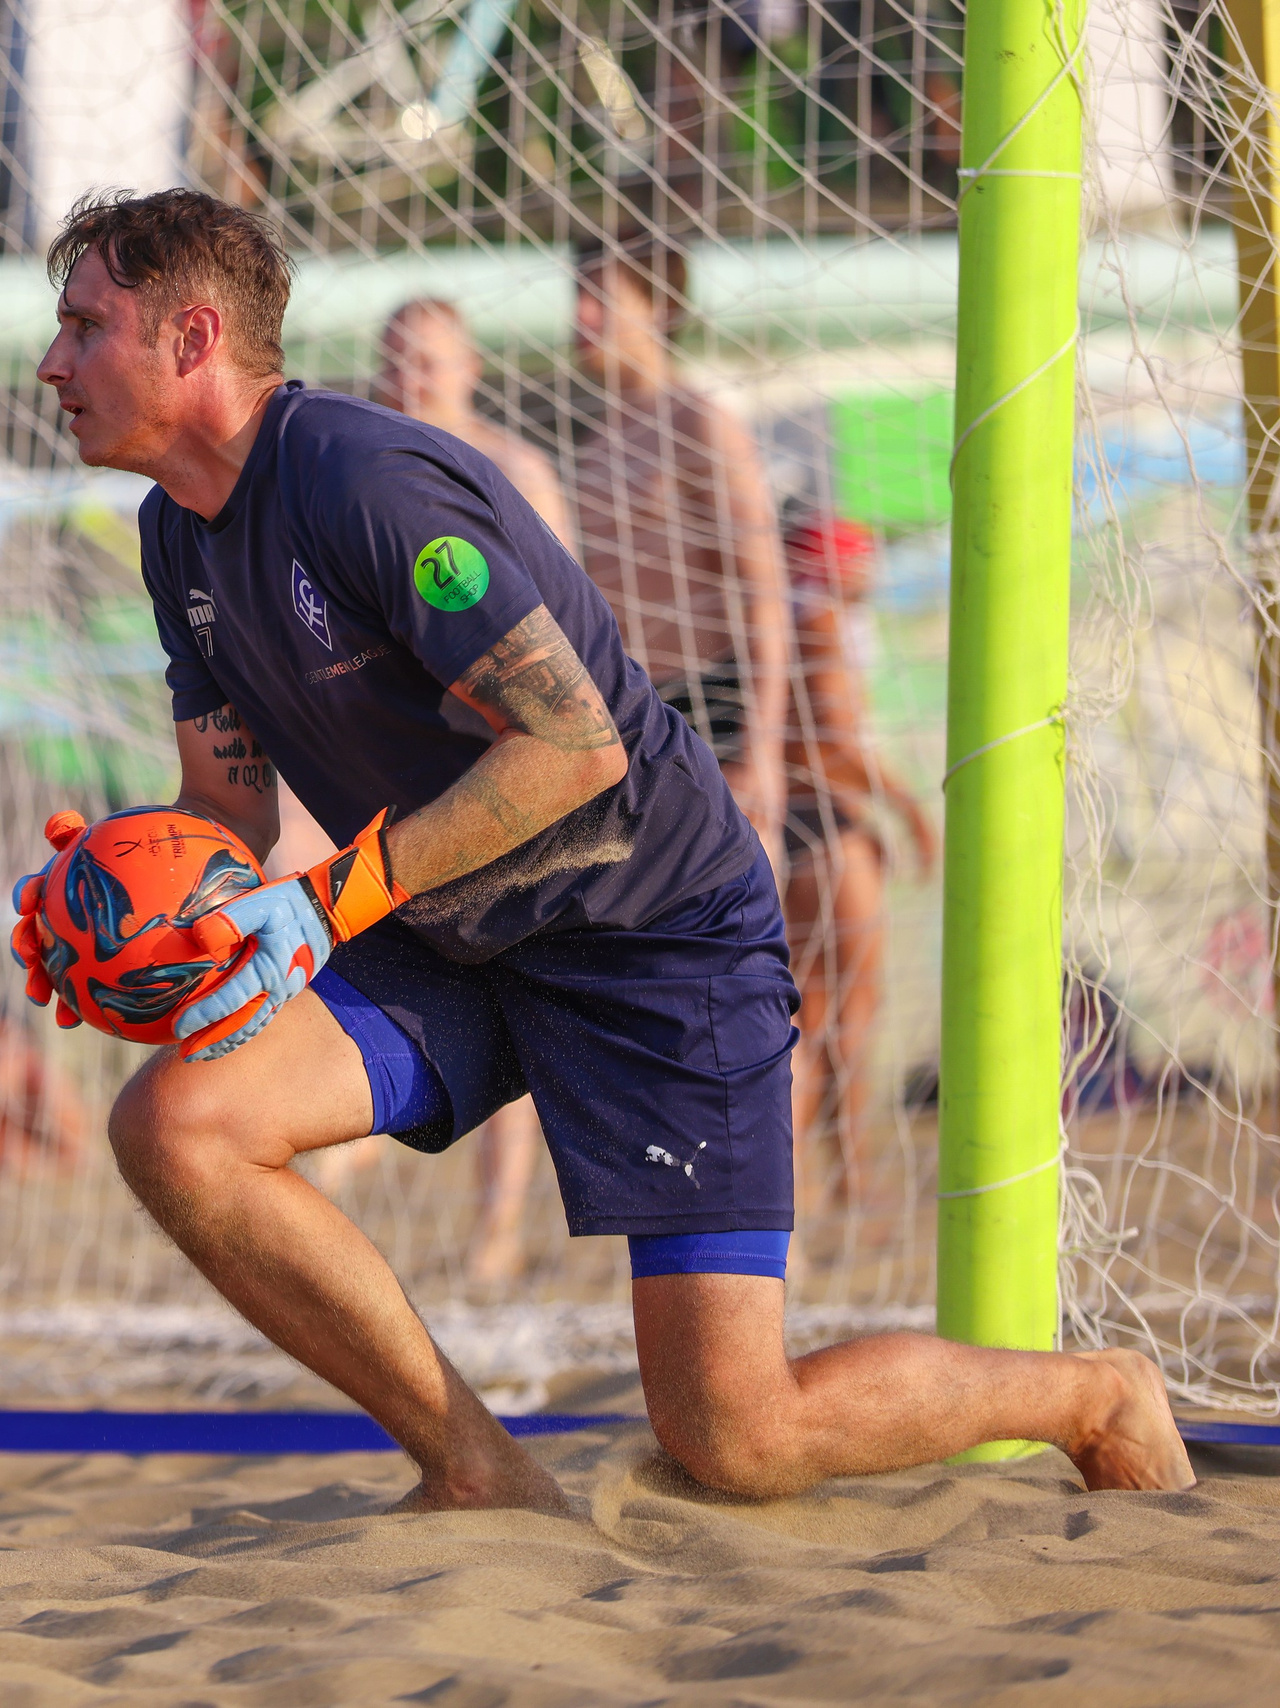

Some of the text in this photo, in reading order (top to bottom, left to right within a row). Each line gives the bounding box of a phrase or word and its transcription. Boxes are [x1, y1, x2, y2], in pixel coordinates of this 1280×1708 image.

[421, 540, 461, 591] 27
[444, 571, 481, 604] FOOTBALL
[460, 584, 479, 604] SHOP
[187, 603, 216, 627] MA
[167, 823, 183, 859] TRIUMPH
